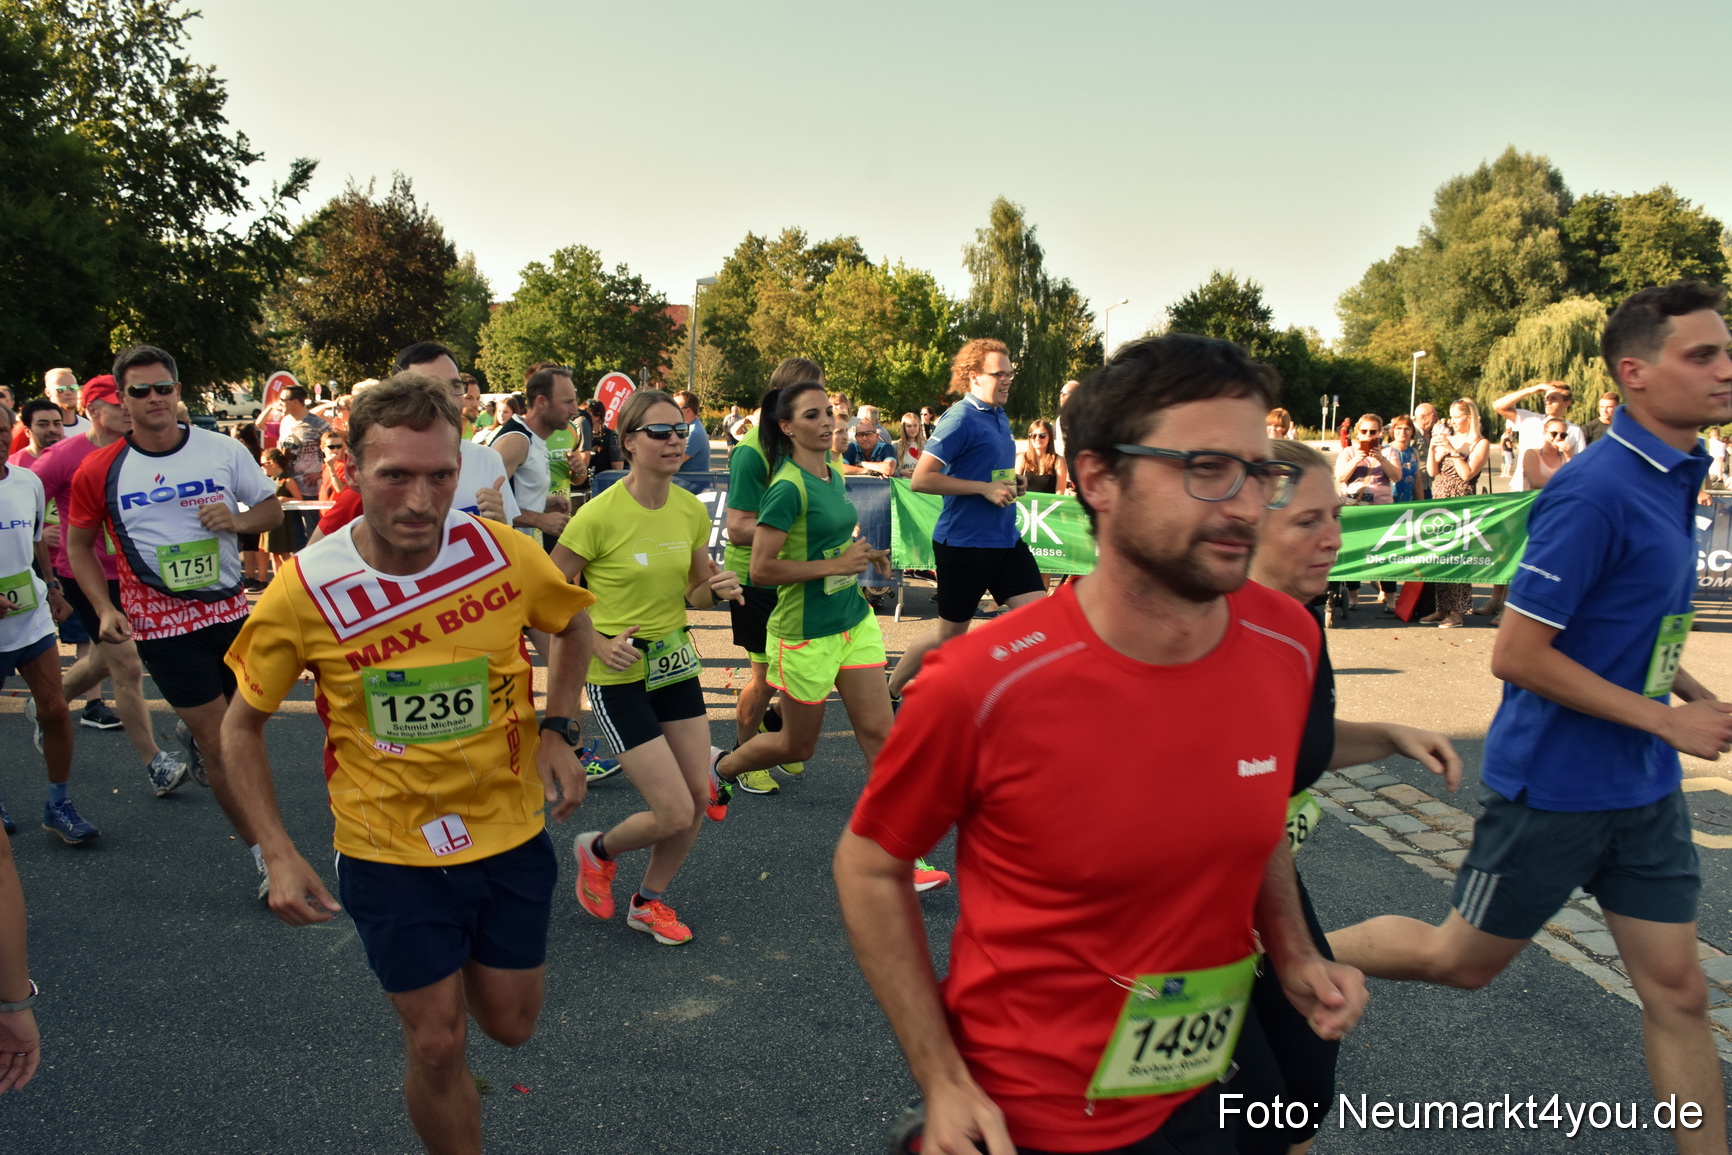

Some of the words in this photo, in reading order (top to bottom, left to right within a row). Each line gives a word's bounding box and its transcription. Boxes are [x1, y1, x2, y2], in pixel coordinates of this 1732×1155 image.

[180, 489, 225, 508] energie
[1371, 507, 1496, 552] AOK
[168, 555, 213, 578] 1751
[1366, 554, 1386, 564] Die
[1388, 553, 1495, 566] Gesundheitskasse.
[345, 622, 431, 673] MAX
[436, 581, 521, 635] BÖGL
[658, 647, 690, 674] 920
[381, 688, 474, 723] 1236
[392, 721, 429, 732] Schmid
[430, 717, 466, 730] Michael
[1132, 1005, 1233, 1062] 1498
